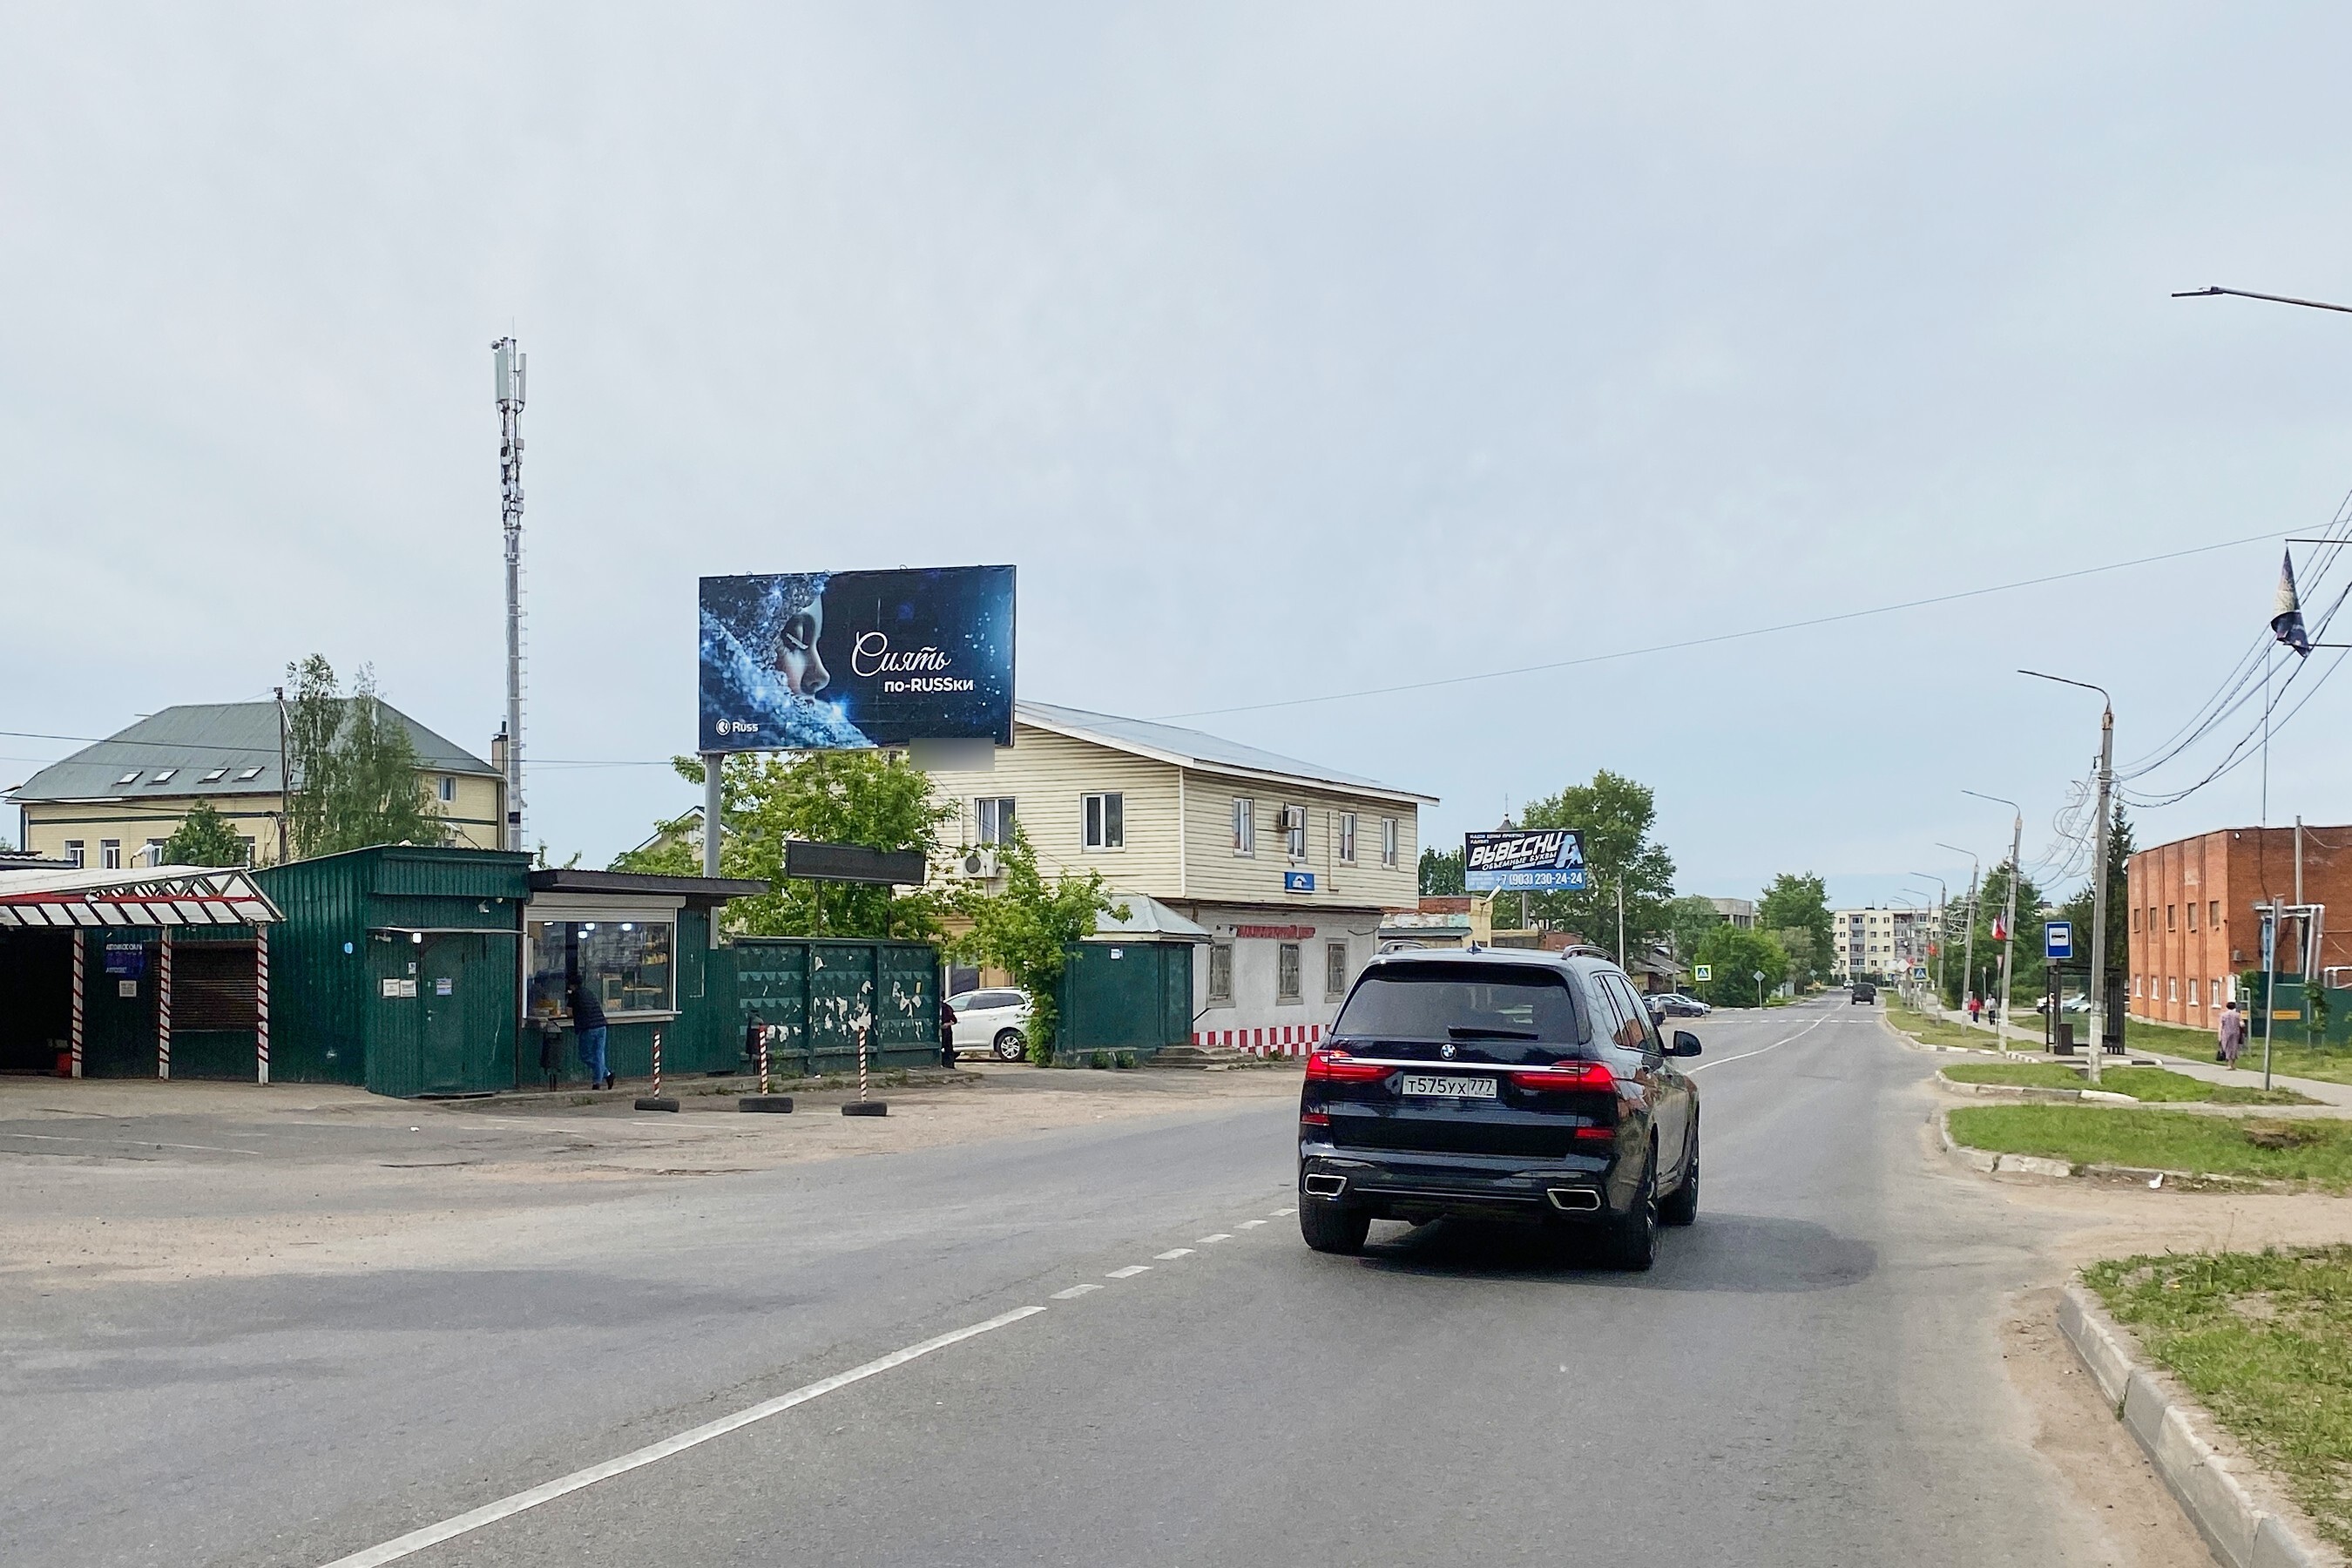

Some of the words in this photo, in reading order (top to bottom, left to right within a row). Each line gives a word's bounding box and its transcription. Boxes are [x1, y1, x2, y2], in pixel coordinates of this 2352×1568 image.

[851, 632, 952, 677] Сиять
[884, 677, 975, 693] по-RUSSки
[732, 721, 759, 733] Russ
[1509, 873, 1533, 886] (903)
[1535, 872, 1583, 885] 230-24-24
